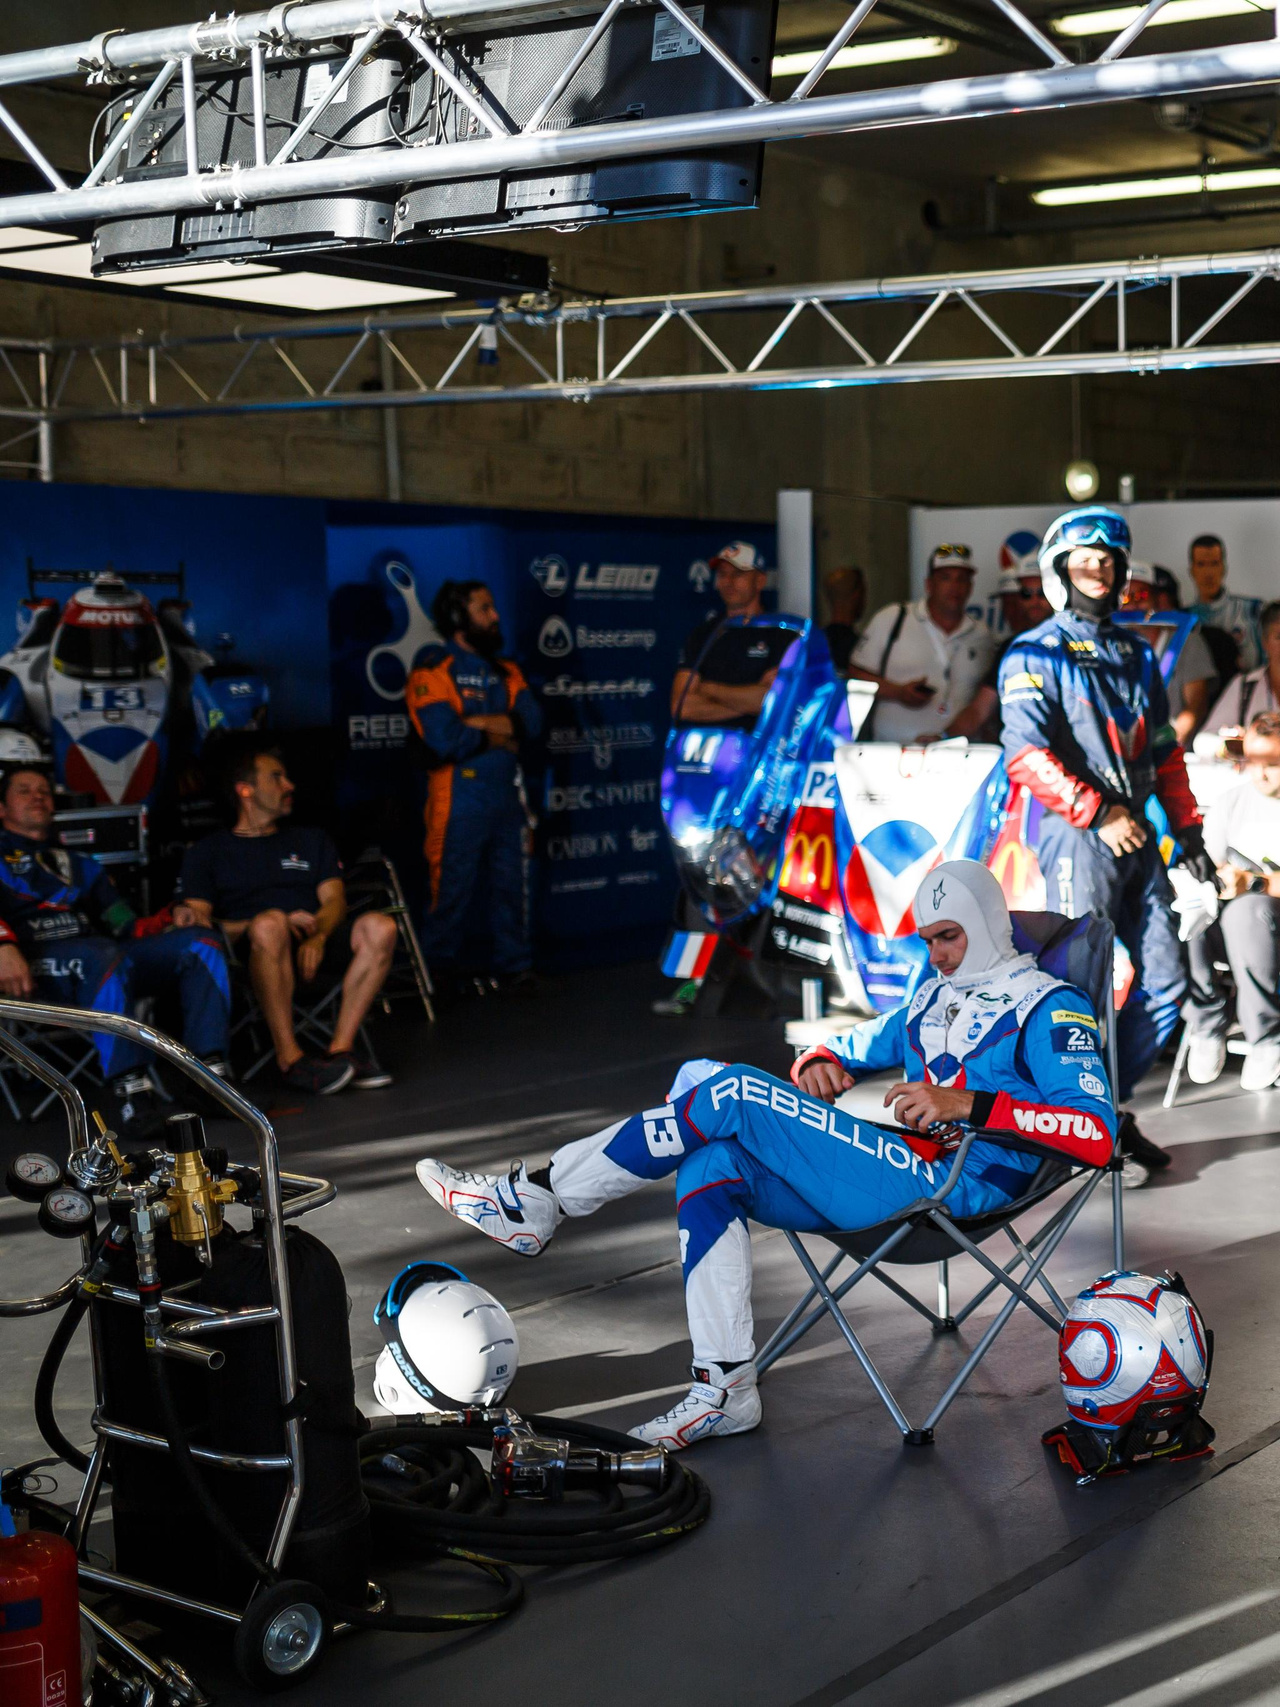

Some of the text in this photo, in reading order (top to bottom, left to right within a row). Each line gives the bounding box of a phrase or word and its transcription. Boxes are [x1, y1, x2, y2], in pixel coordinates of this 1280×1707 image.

[574, 562, 661, 591] LEMO
[1082, 1080, 1103, 1093] ion
[642, 1104, 685, 1158] 13
[710, 1075, 935, 1185] REBELLION
